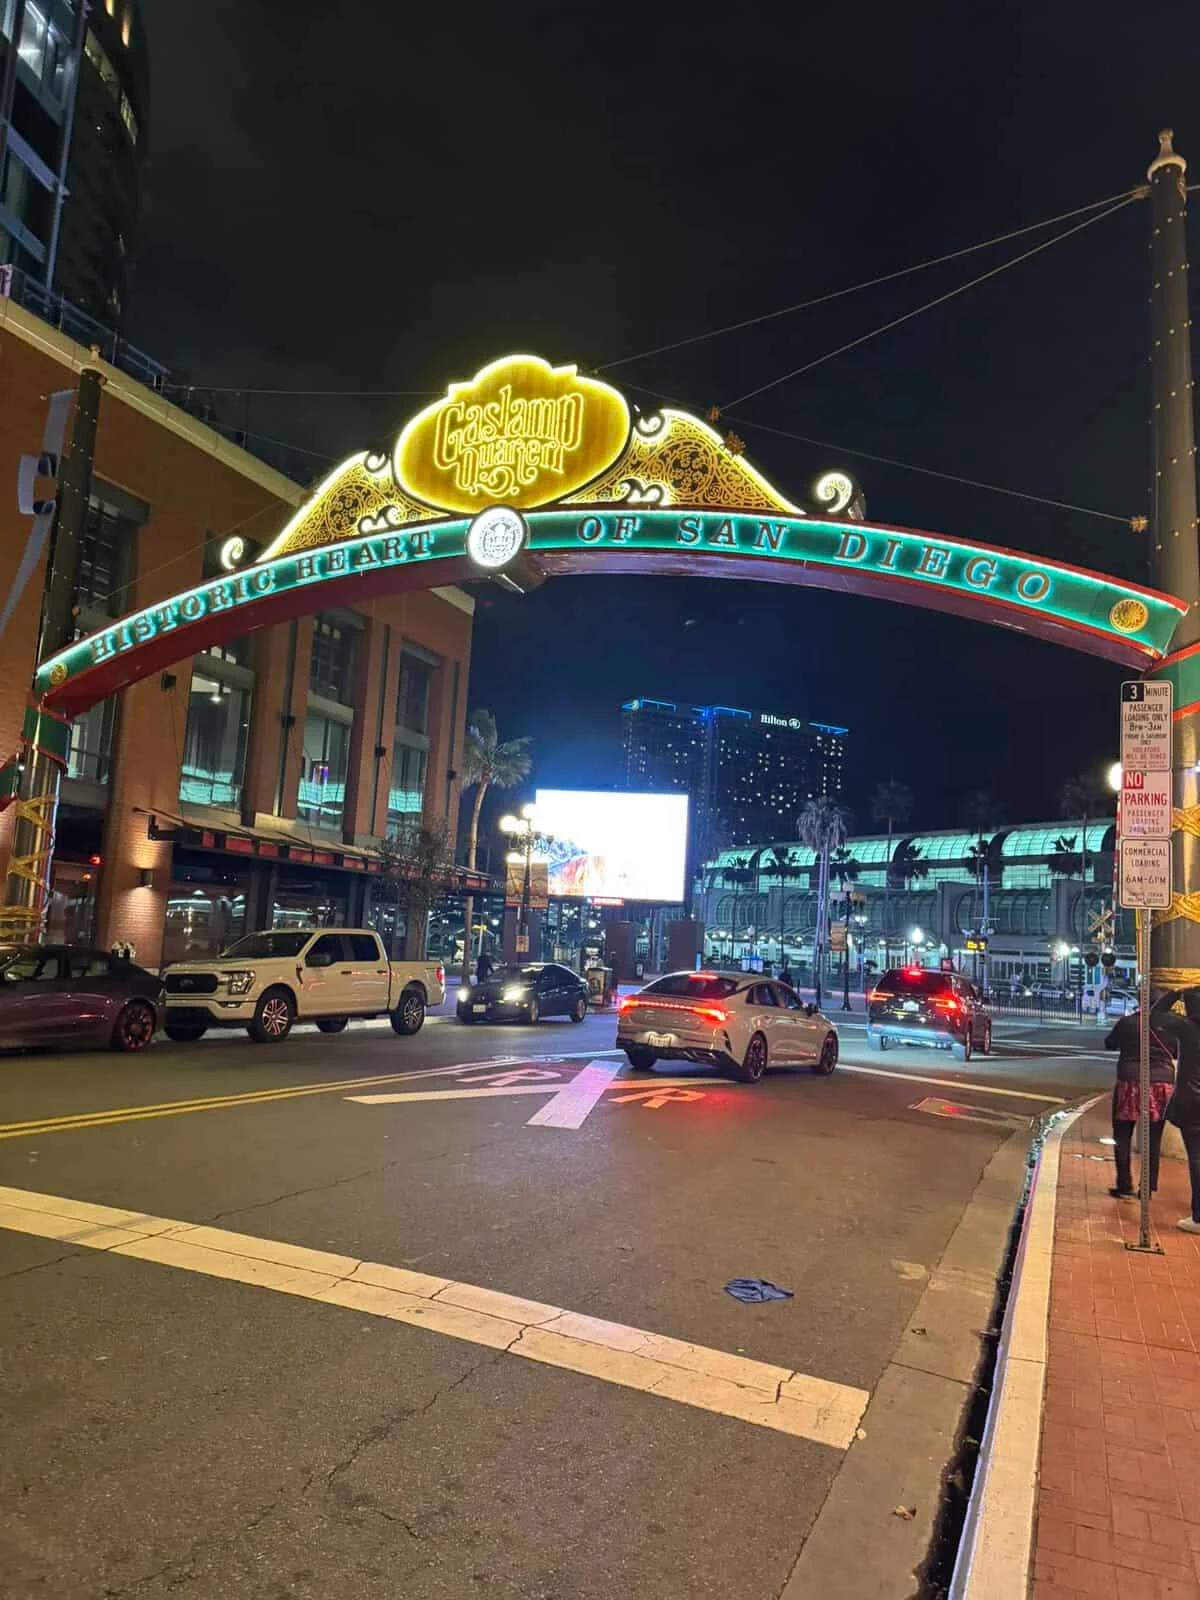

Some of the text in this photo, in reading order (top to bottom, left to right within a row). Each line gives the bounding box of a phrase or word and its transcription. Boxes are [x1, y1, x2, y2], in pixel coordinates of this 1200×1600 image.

[433, 384, 585, 471] Gaslamp
[454, 436, 564, 498] Quarter
[89, 566, 277, 664] HISTORIC
[296, 530, 435, 584] HEART
[576, 515, 640, 544] OF
[676, 517, 790, 552] SAN
[834, 531, 1052, 602] DIEGO
[1129, 684, 1169, 700] 3 MINUTE
[1129, 703, 1163, 712] PASSENGER
[761, 714, 787, 727] Hilton
[1124, 712, 1168, 722] LOADING ONLY
[1126, 771, 1143, 788] NO
[1124, 792, 1168, 806] PARKING
[1127, 809, 1164, 817] PASSENGER
[1124, 847, 1168, 857] COMMERCIAL
[1131, 859, 1161, 868] LOADING
[1126, 875, 1166, 884] 6AM-6PM
